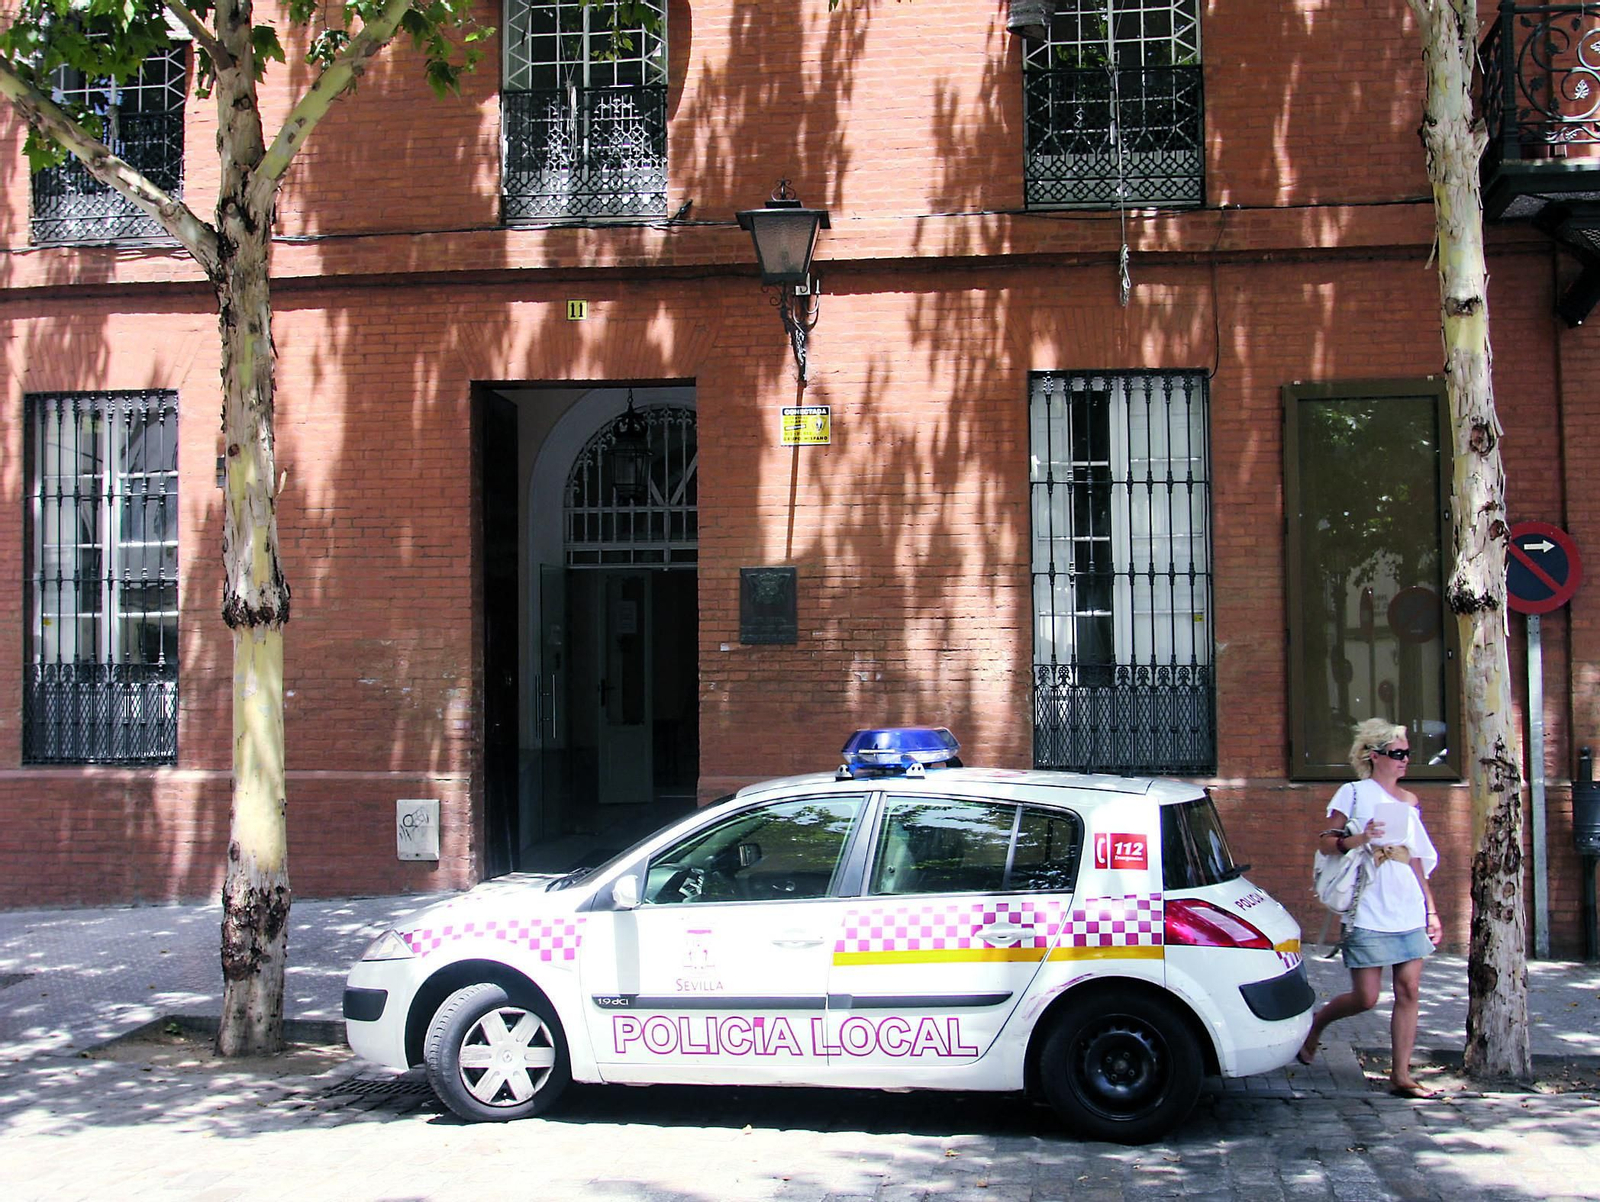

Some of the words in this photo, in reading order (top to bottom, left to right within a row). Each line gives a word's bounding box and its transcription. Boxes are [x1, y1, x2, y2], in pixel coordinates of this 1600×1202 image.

[570, 302, 583, 318] 11
[1114, 842, 1144, 855] 112
[810, 1017, 979, 1057] LOCAL
